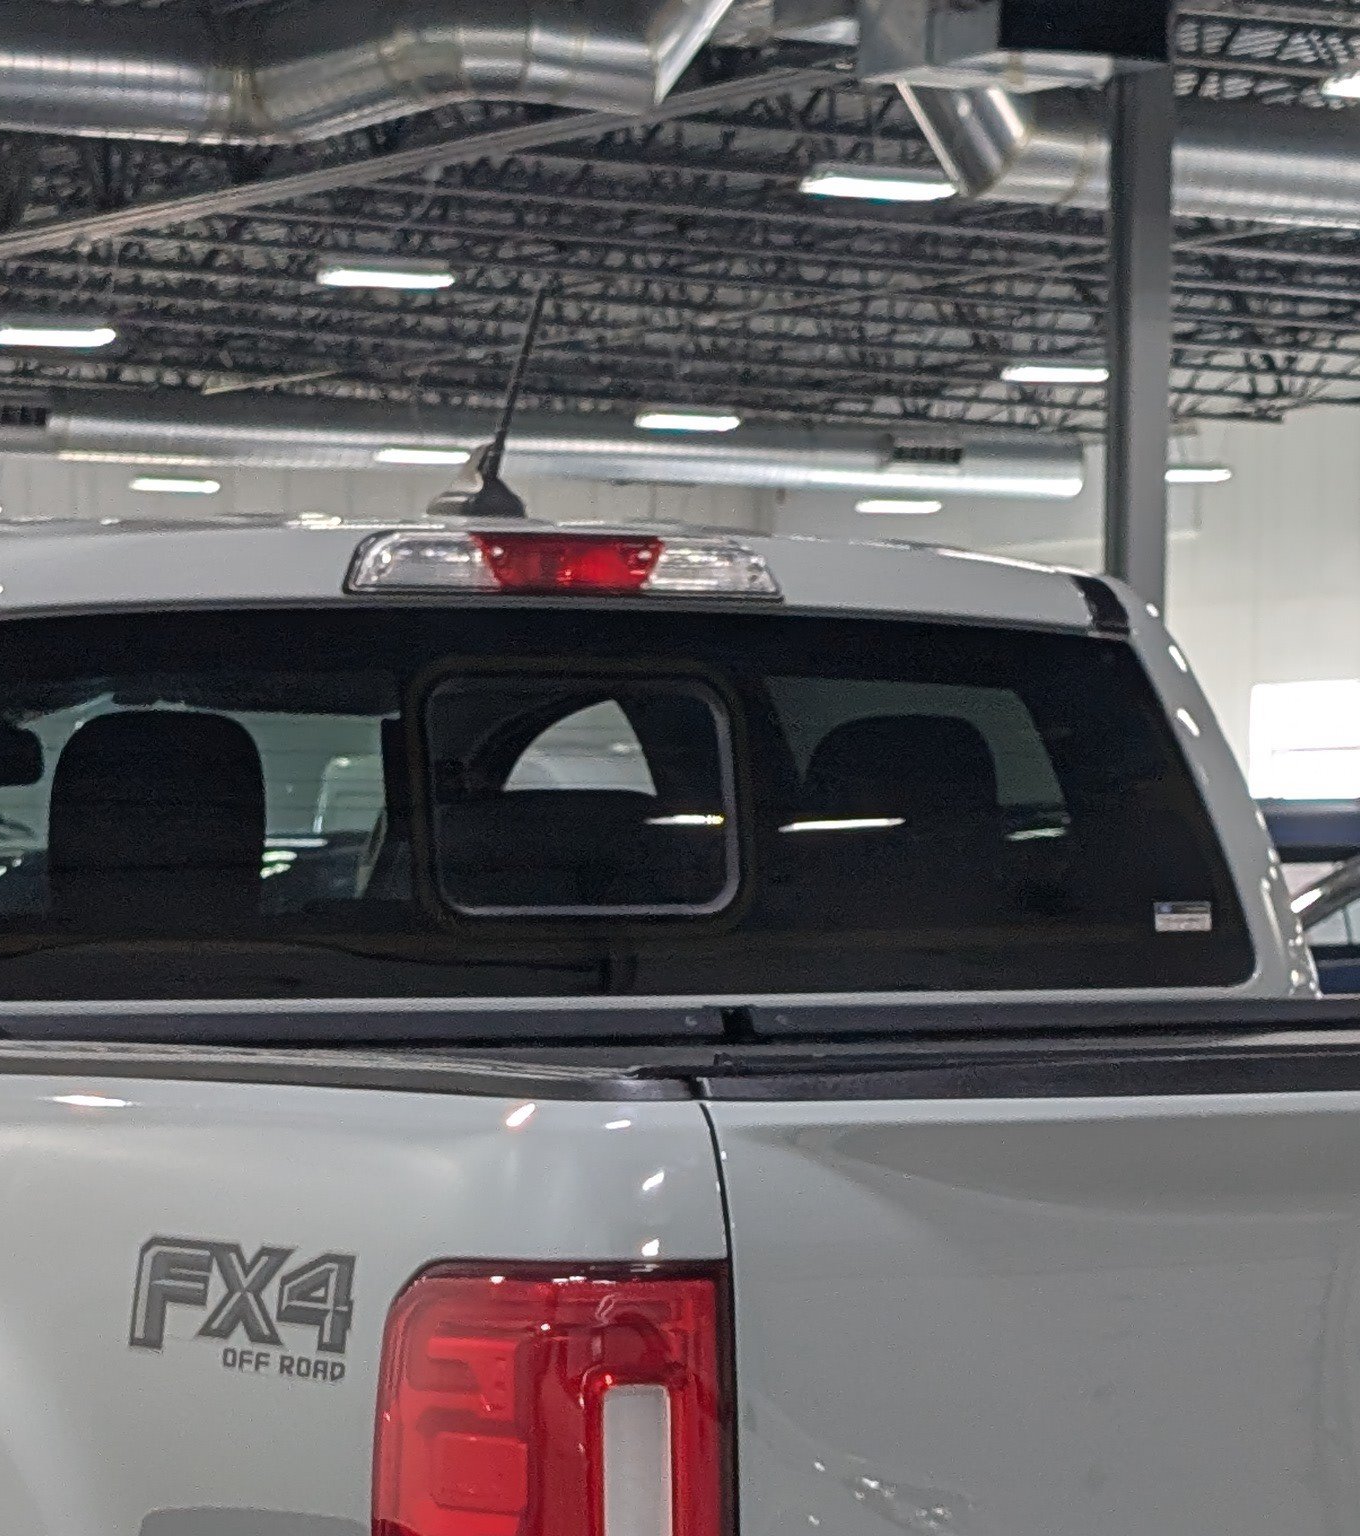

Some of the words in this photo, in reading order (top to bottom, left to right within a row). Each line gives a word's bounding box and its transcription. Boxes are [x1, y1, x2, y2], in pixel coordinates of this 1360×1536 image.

[128, 1235, 357, 1354] FX4
[222, 1347, 271, 1372] OFF
[279, 1354, 346, 1381] ROAD
